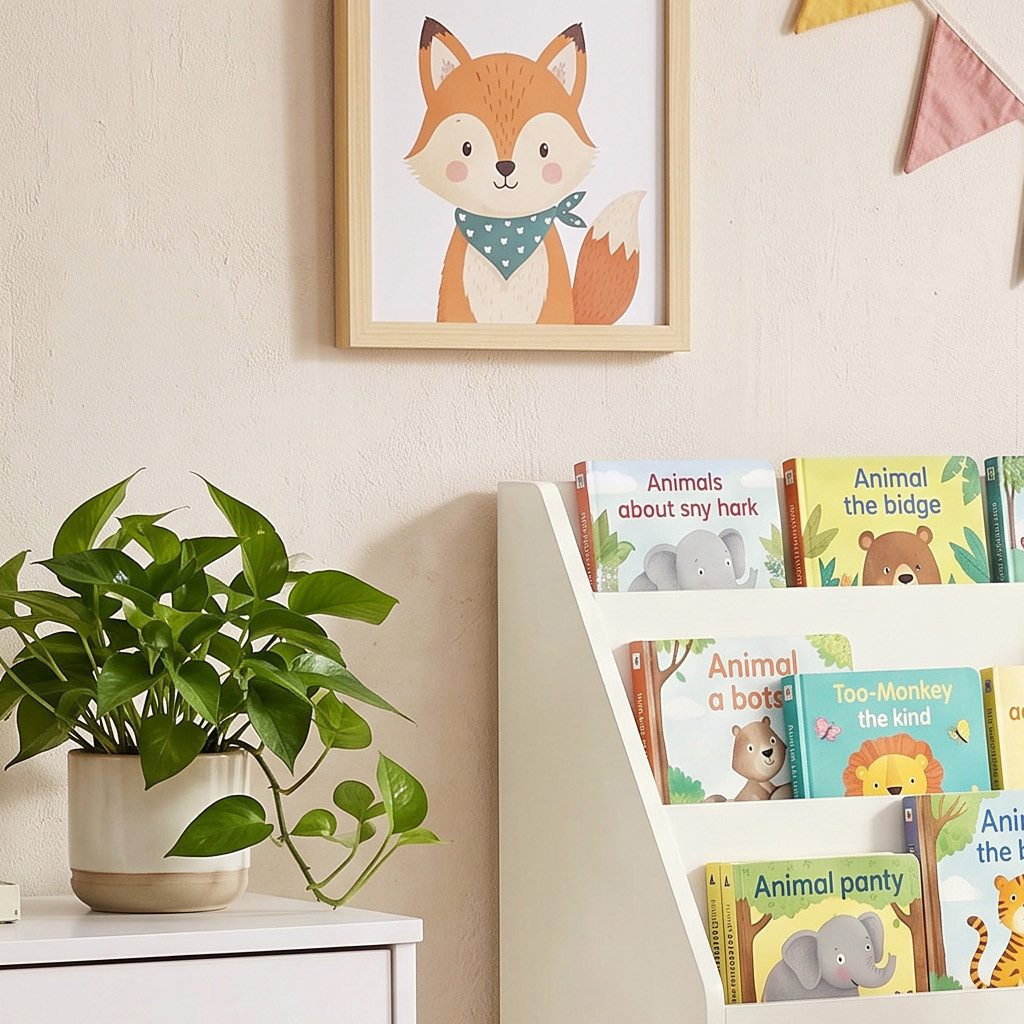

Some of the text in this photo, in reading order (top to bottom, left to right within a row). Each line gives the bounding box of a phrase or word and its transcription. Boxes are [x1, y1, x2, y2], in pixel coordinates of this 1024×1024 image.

[647, 472, 723, 492] Animals
[854, 466, 928, 488] Animal
[618, 498, 759, 521] about sny hark
[843, 493, 941, 519] the bidge
[708, 649, 798, 678] Animal
[708, 692, 724, 711] a
[833, 681, 953, 704] Too-Monkey
[857, 706, 932, 729] the kind
[976, 840, 1012, 863] the
[754, 869, 904, 901] Animal panty
